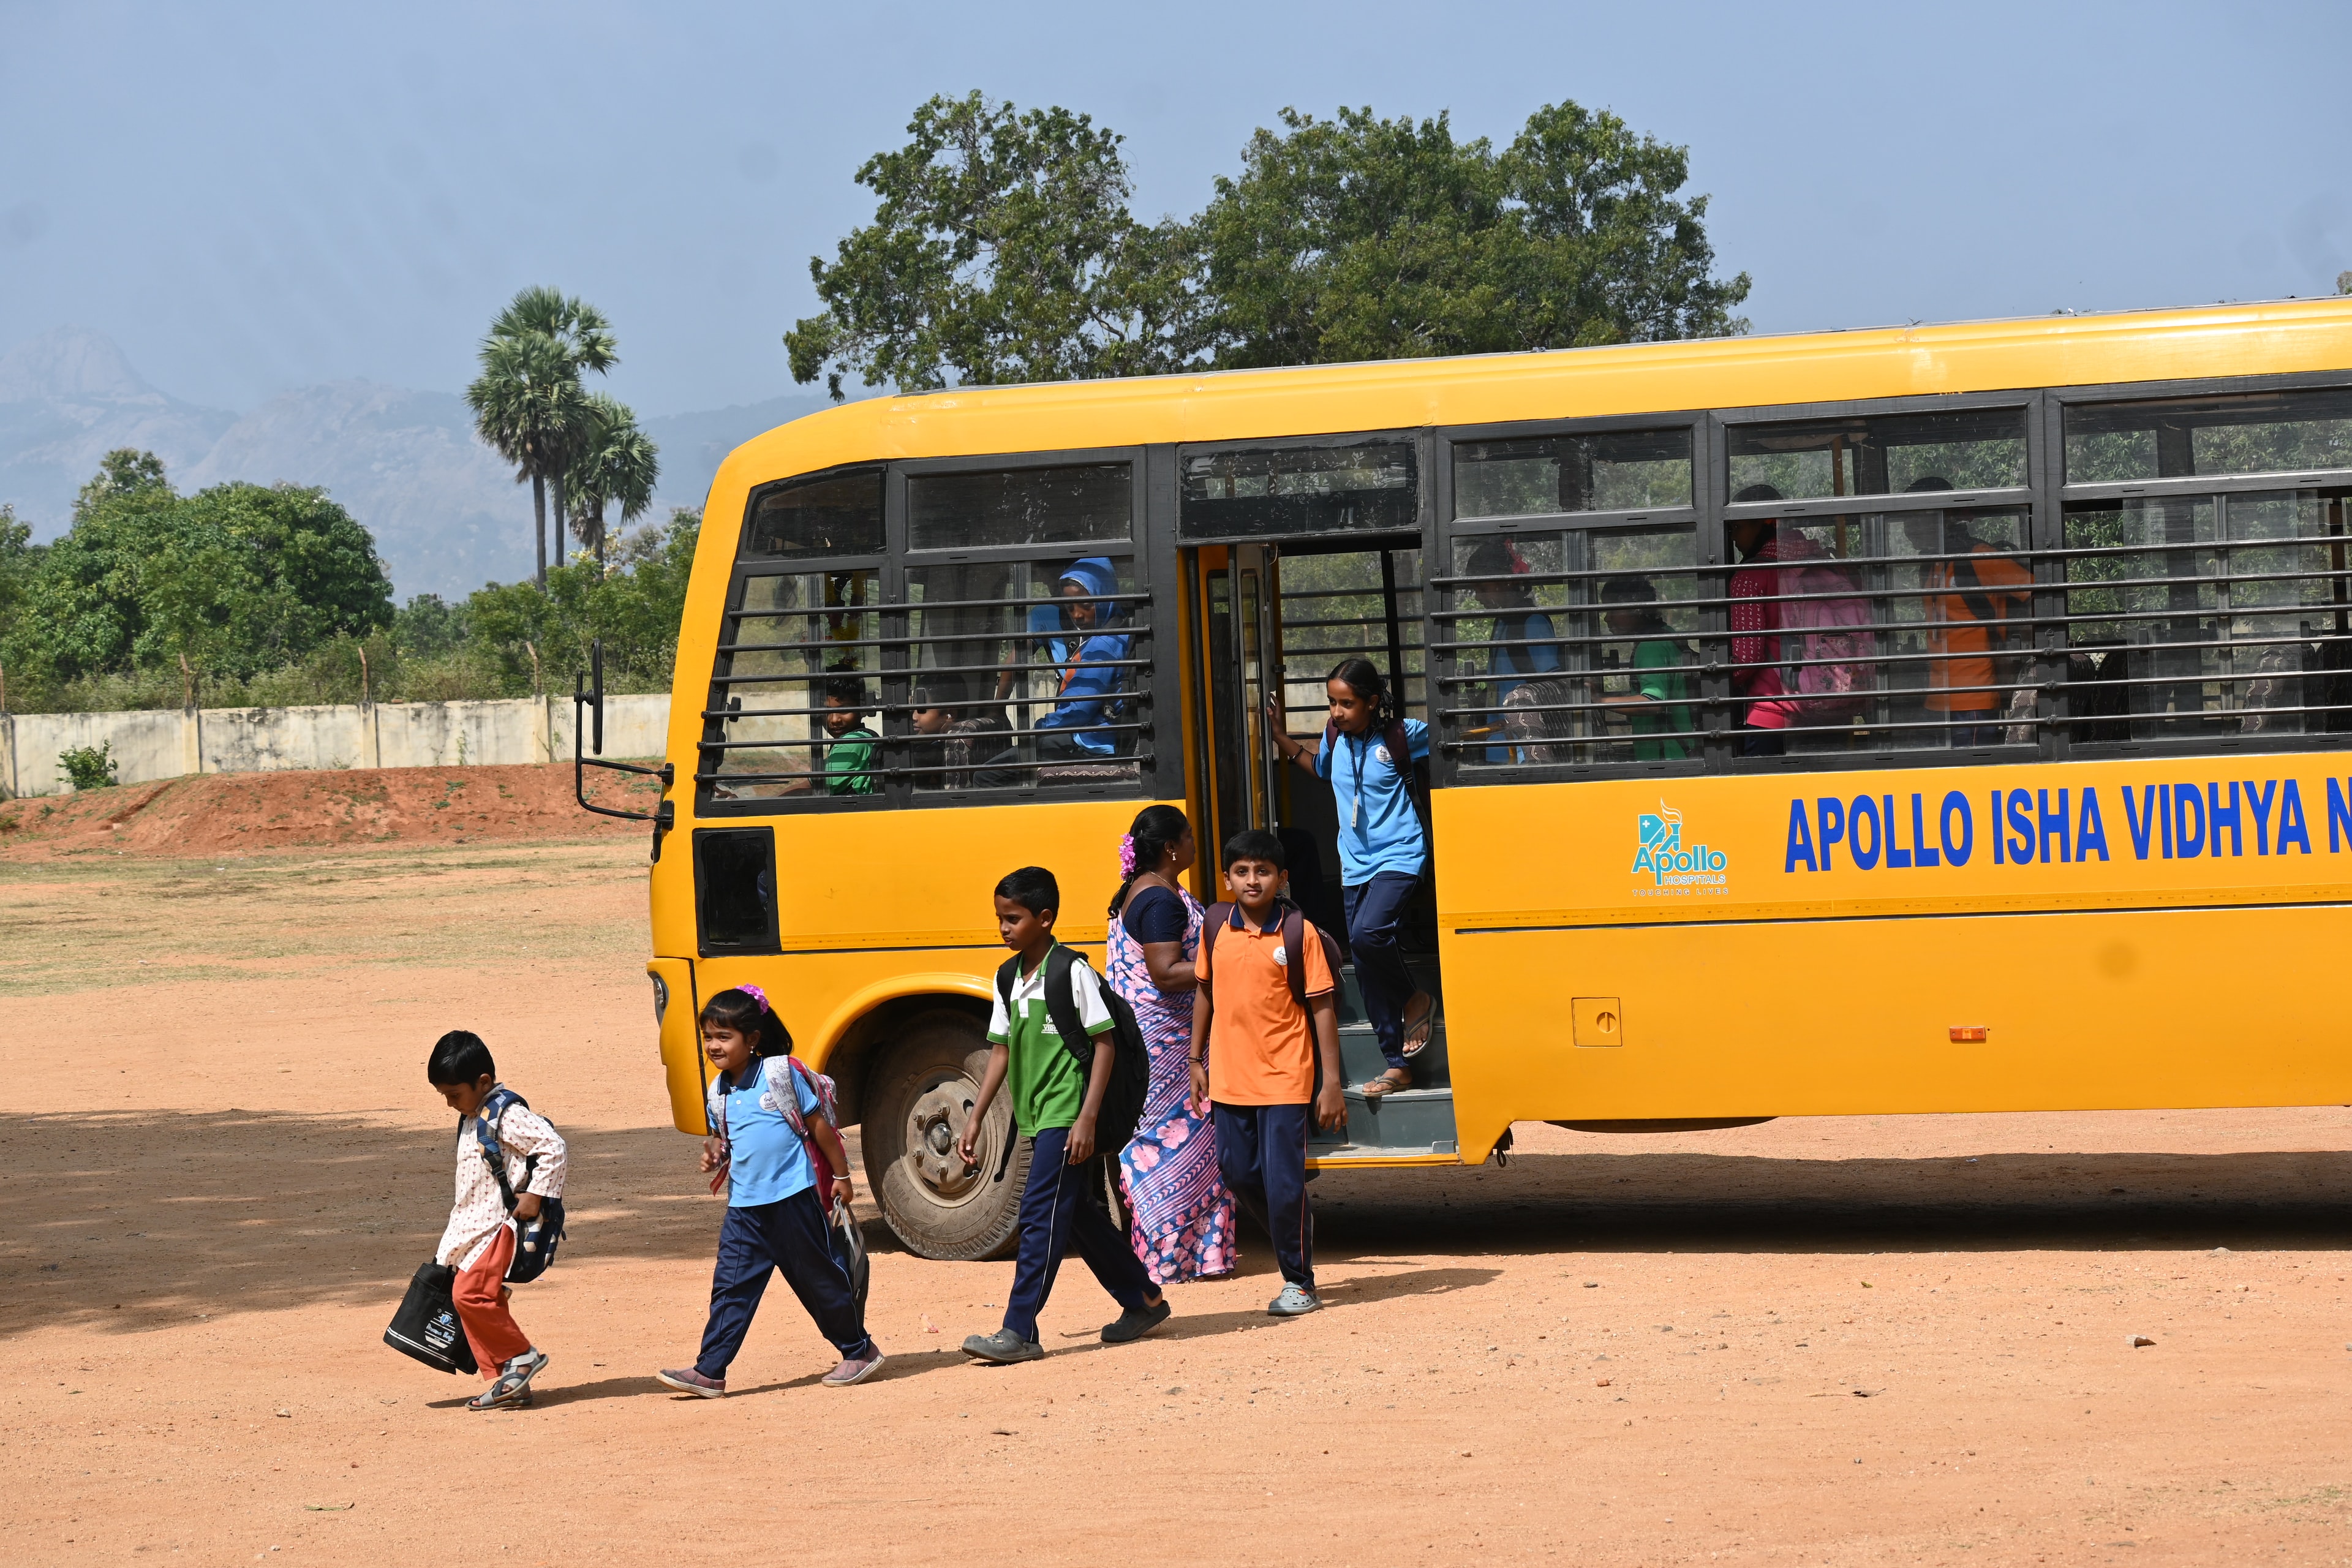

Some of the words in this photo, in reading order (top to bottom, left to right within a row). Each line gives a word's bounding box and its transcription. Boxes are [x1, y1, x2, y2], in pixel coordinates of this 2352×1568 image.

[1785, 791, 1973, 873] APOLLO
[1992, 787, 2109, 865] ISHA
[2122, 779, 2312, 861] VIDHYA
[1630, 845, 1727, 886] Apollo
[1665, 875, 1725, 885] HOSPITALS
